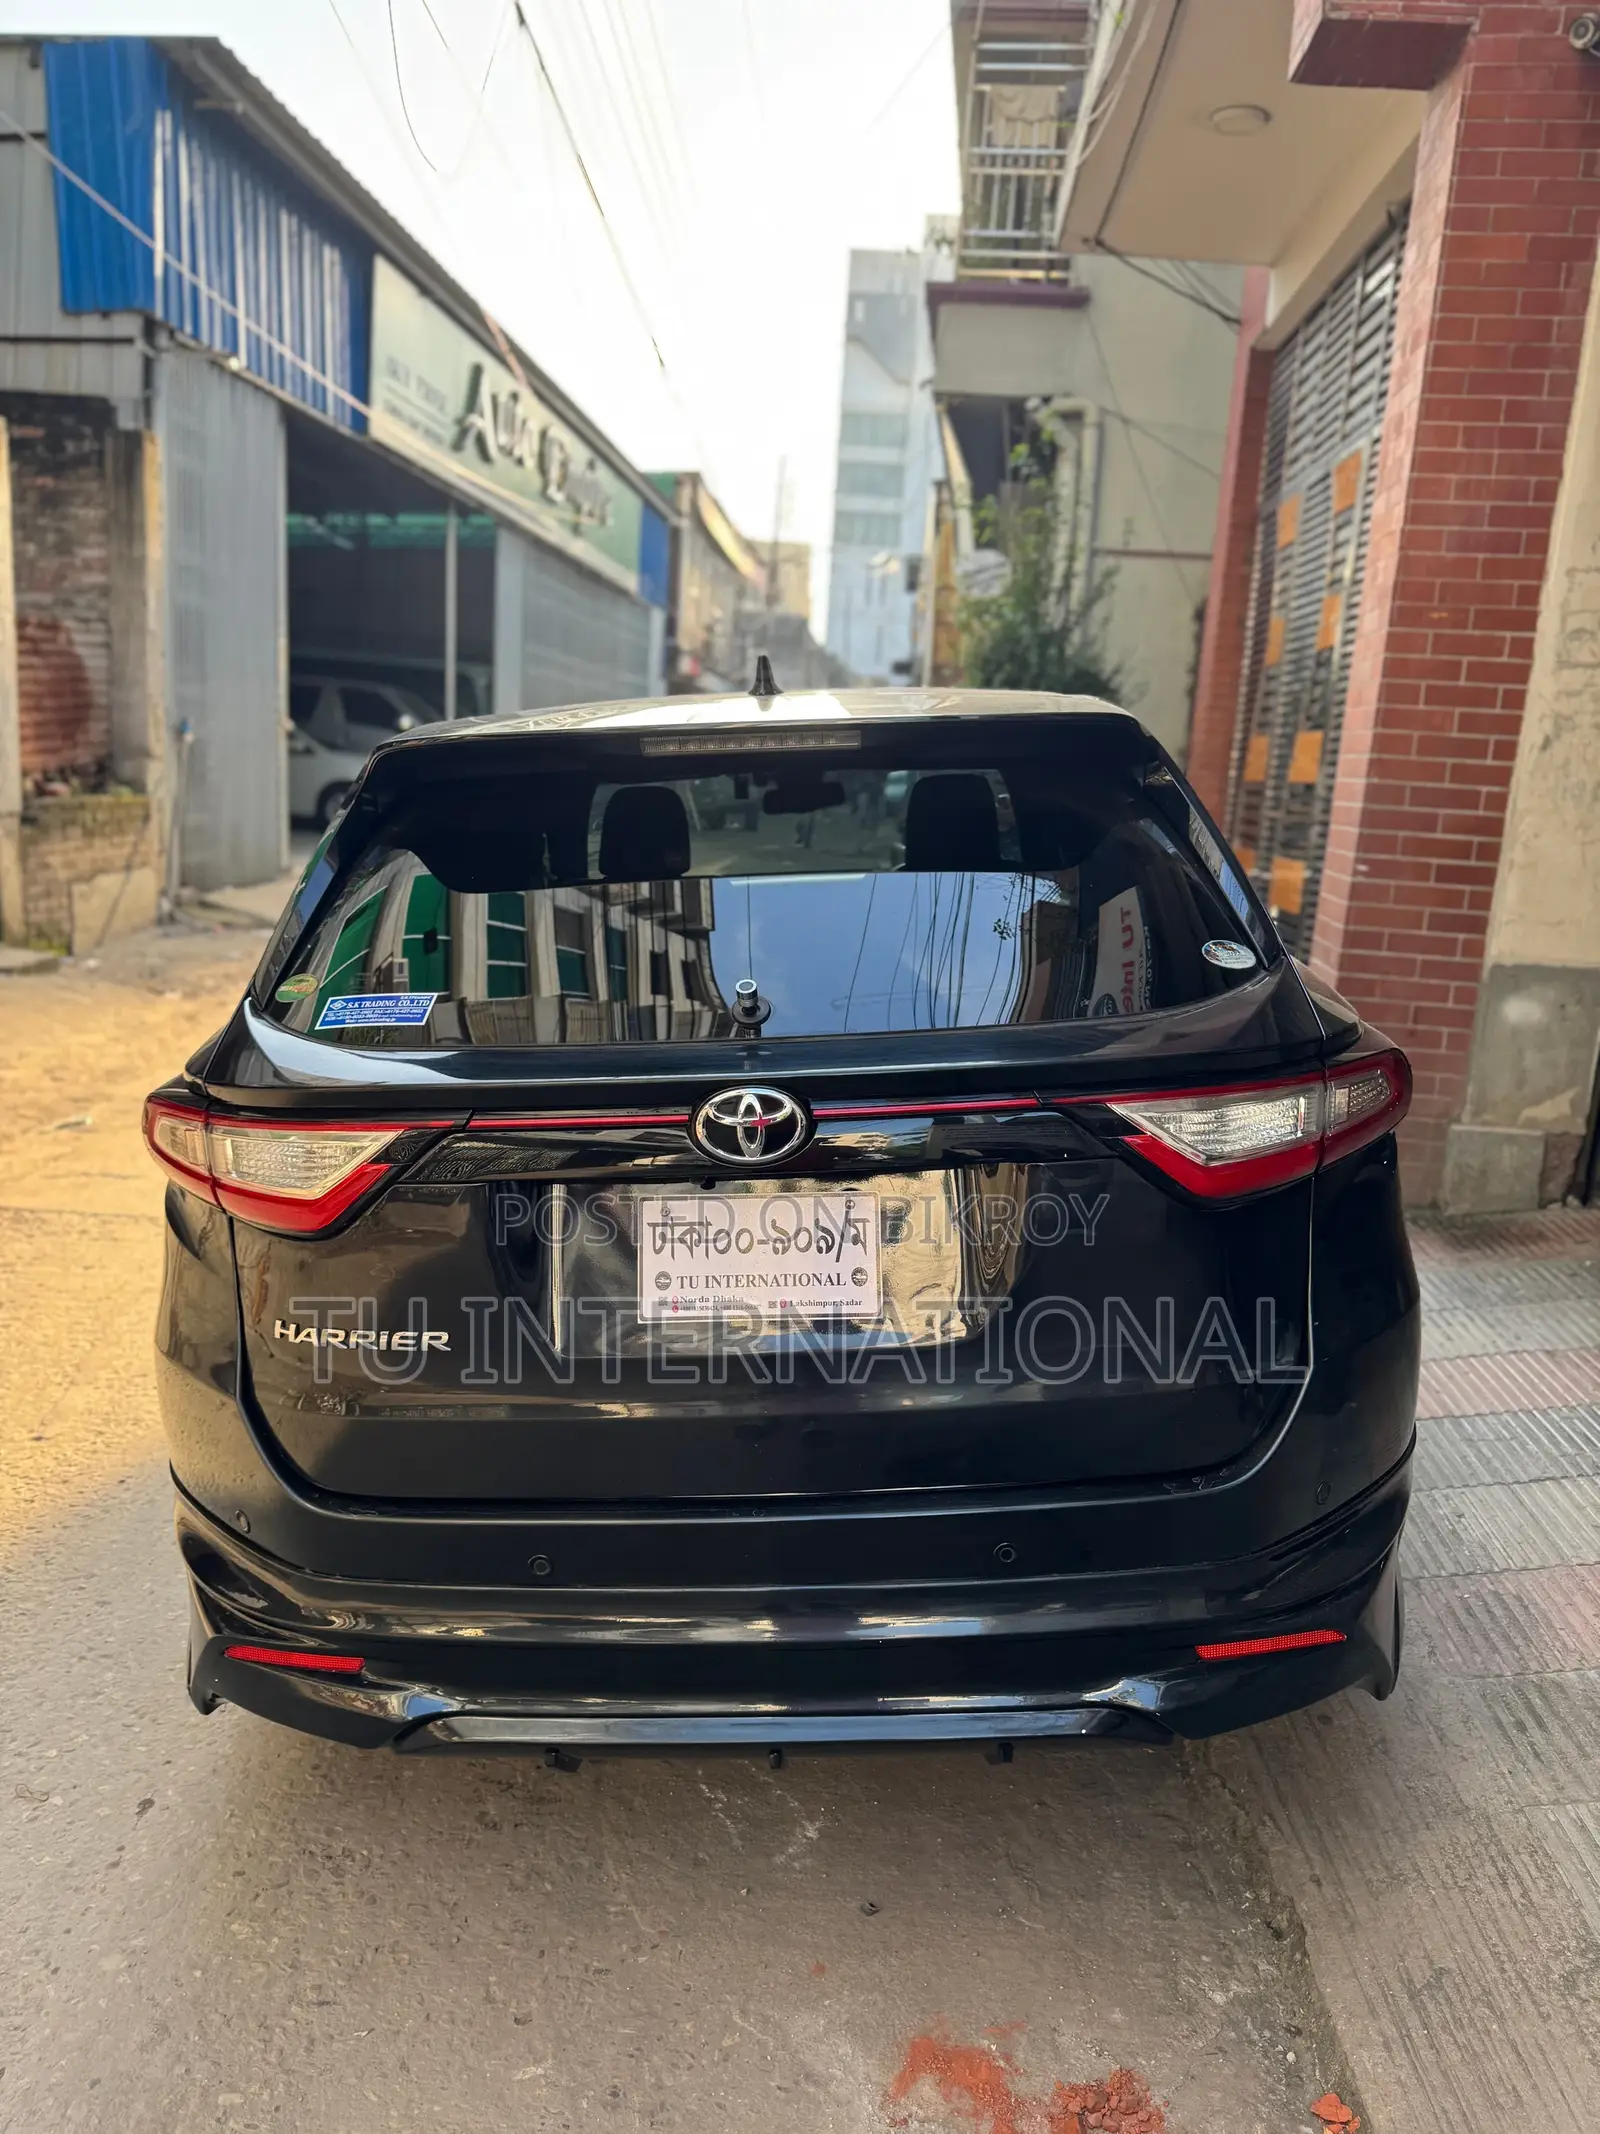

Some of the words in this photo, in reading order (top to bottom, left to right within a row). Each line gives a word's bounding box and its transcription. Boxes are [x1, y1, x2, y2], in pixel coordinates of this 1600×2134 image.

[361, 1000, 396, 1008] TRADING
[676, 1275, 699, 1289] TU
[705, 1272, 847, 1289] INTERNATIONAL
[840, 1298, 863, 1307] Sadar
[273, 1319, 452, 1352] HARRIER
